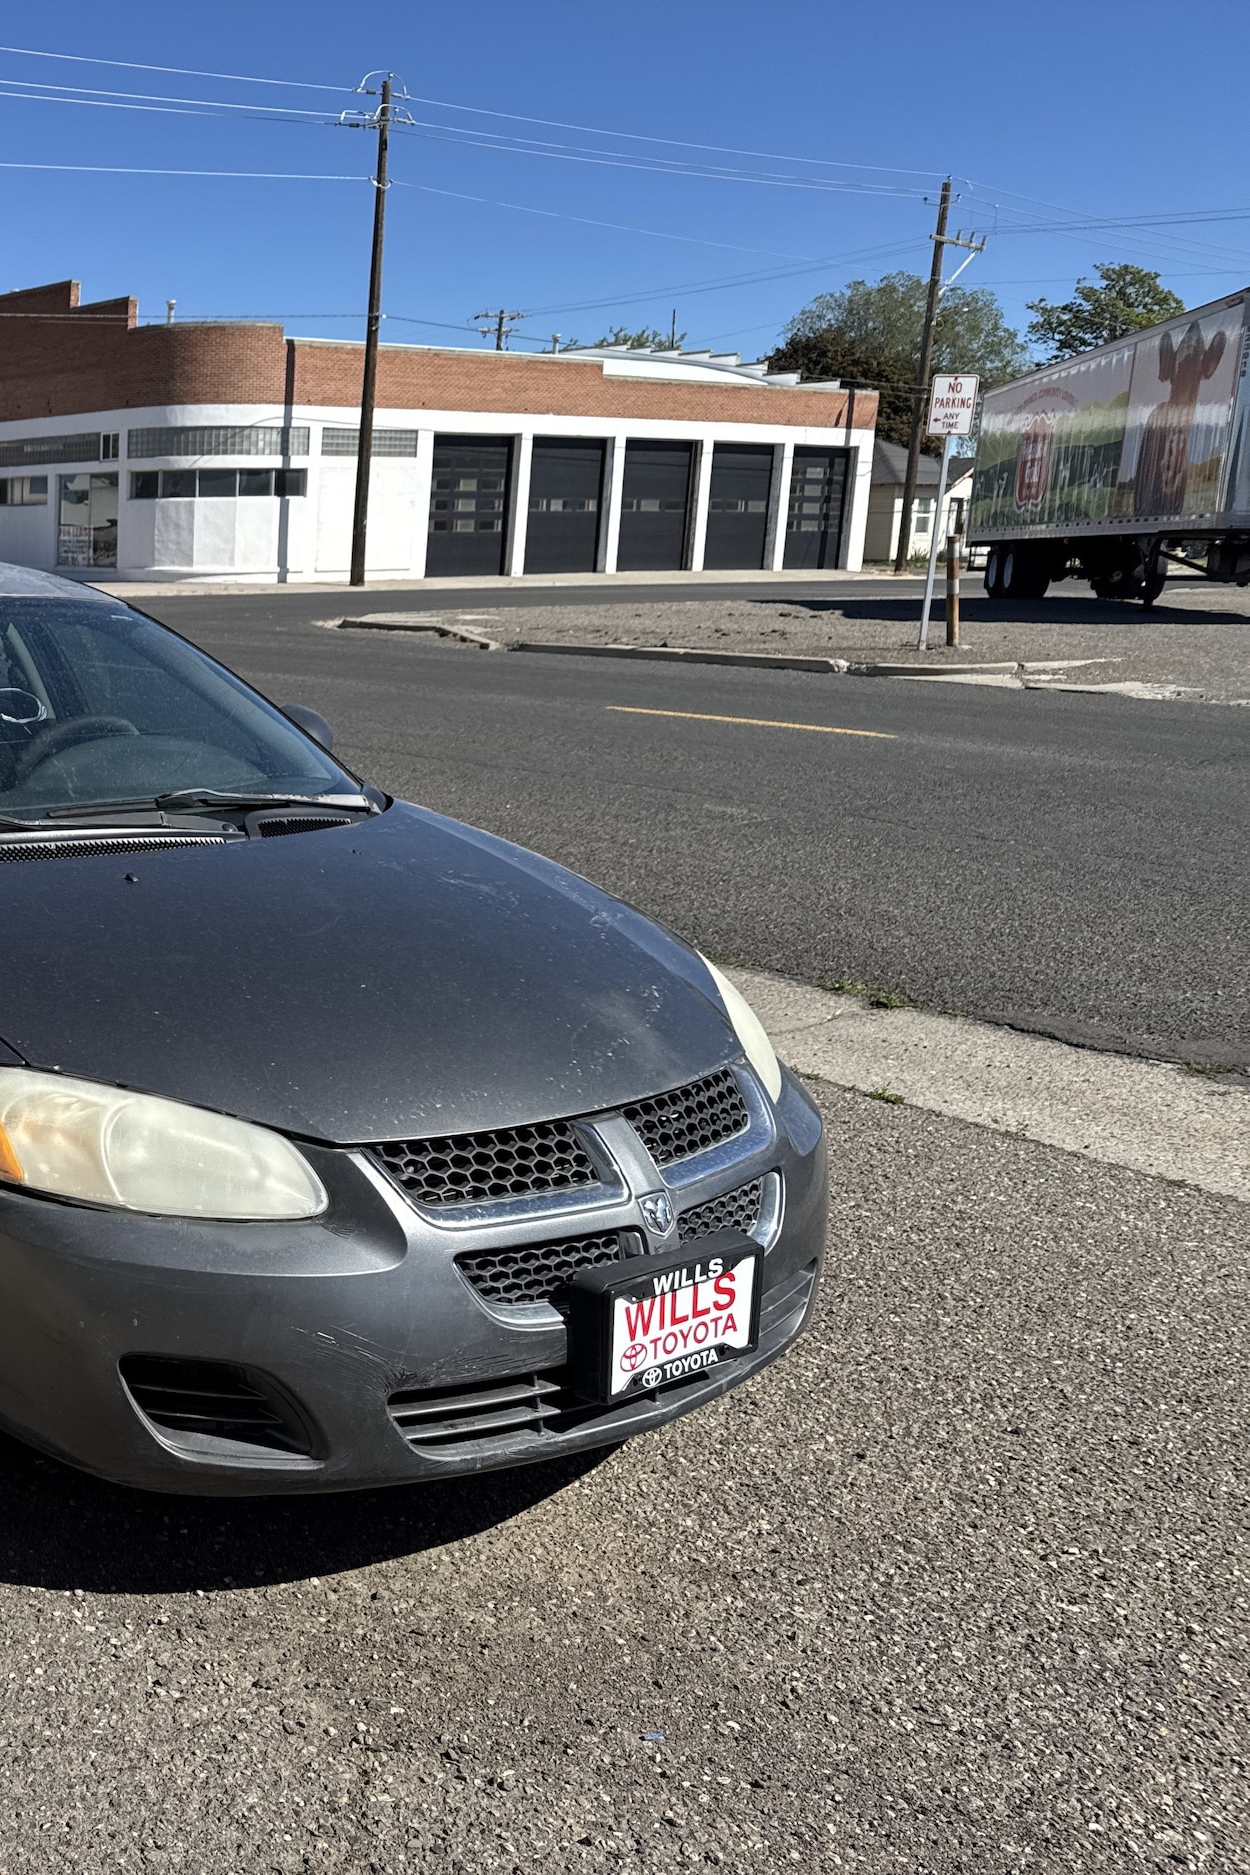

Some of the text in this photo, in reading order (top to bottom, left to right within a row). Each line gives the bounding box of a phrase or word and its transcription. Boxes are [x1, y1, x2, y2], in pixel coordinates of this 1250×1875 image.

[947, 382, 963, 394] NO
[934, 397, 972, 409] PARKING
[941, 421, 959, 429] TIME
[943, 412, 960, 420] ANY
[652, 1257, 724, 1295] WILLS
[624, 1272, 736, 1342] WILLS
[649, 1312, 738, 1360] TOYOTA
[663, 1348, 719, 1379] TOYOTA
